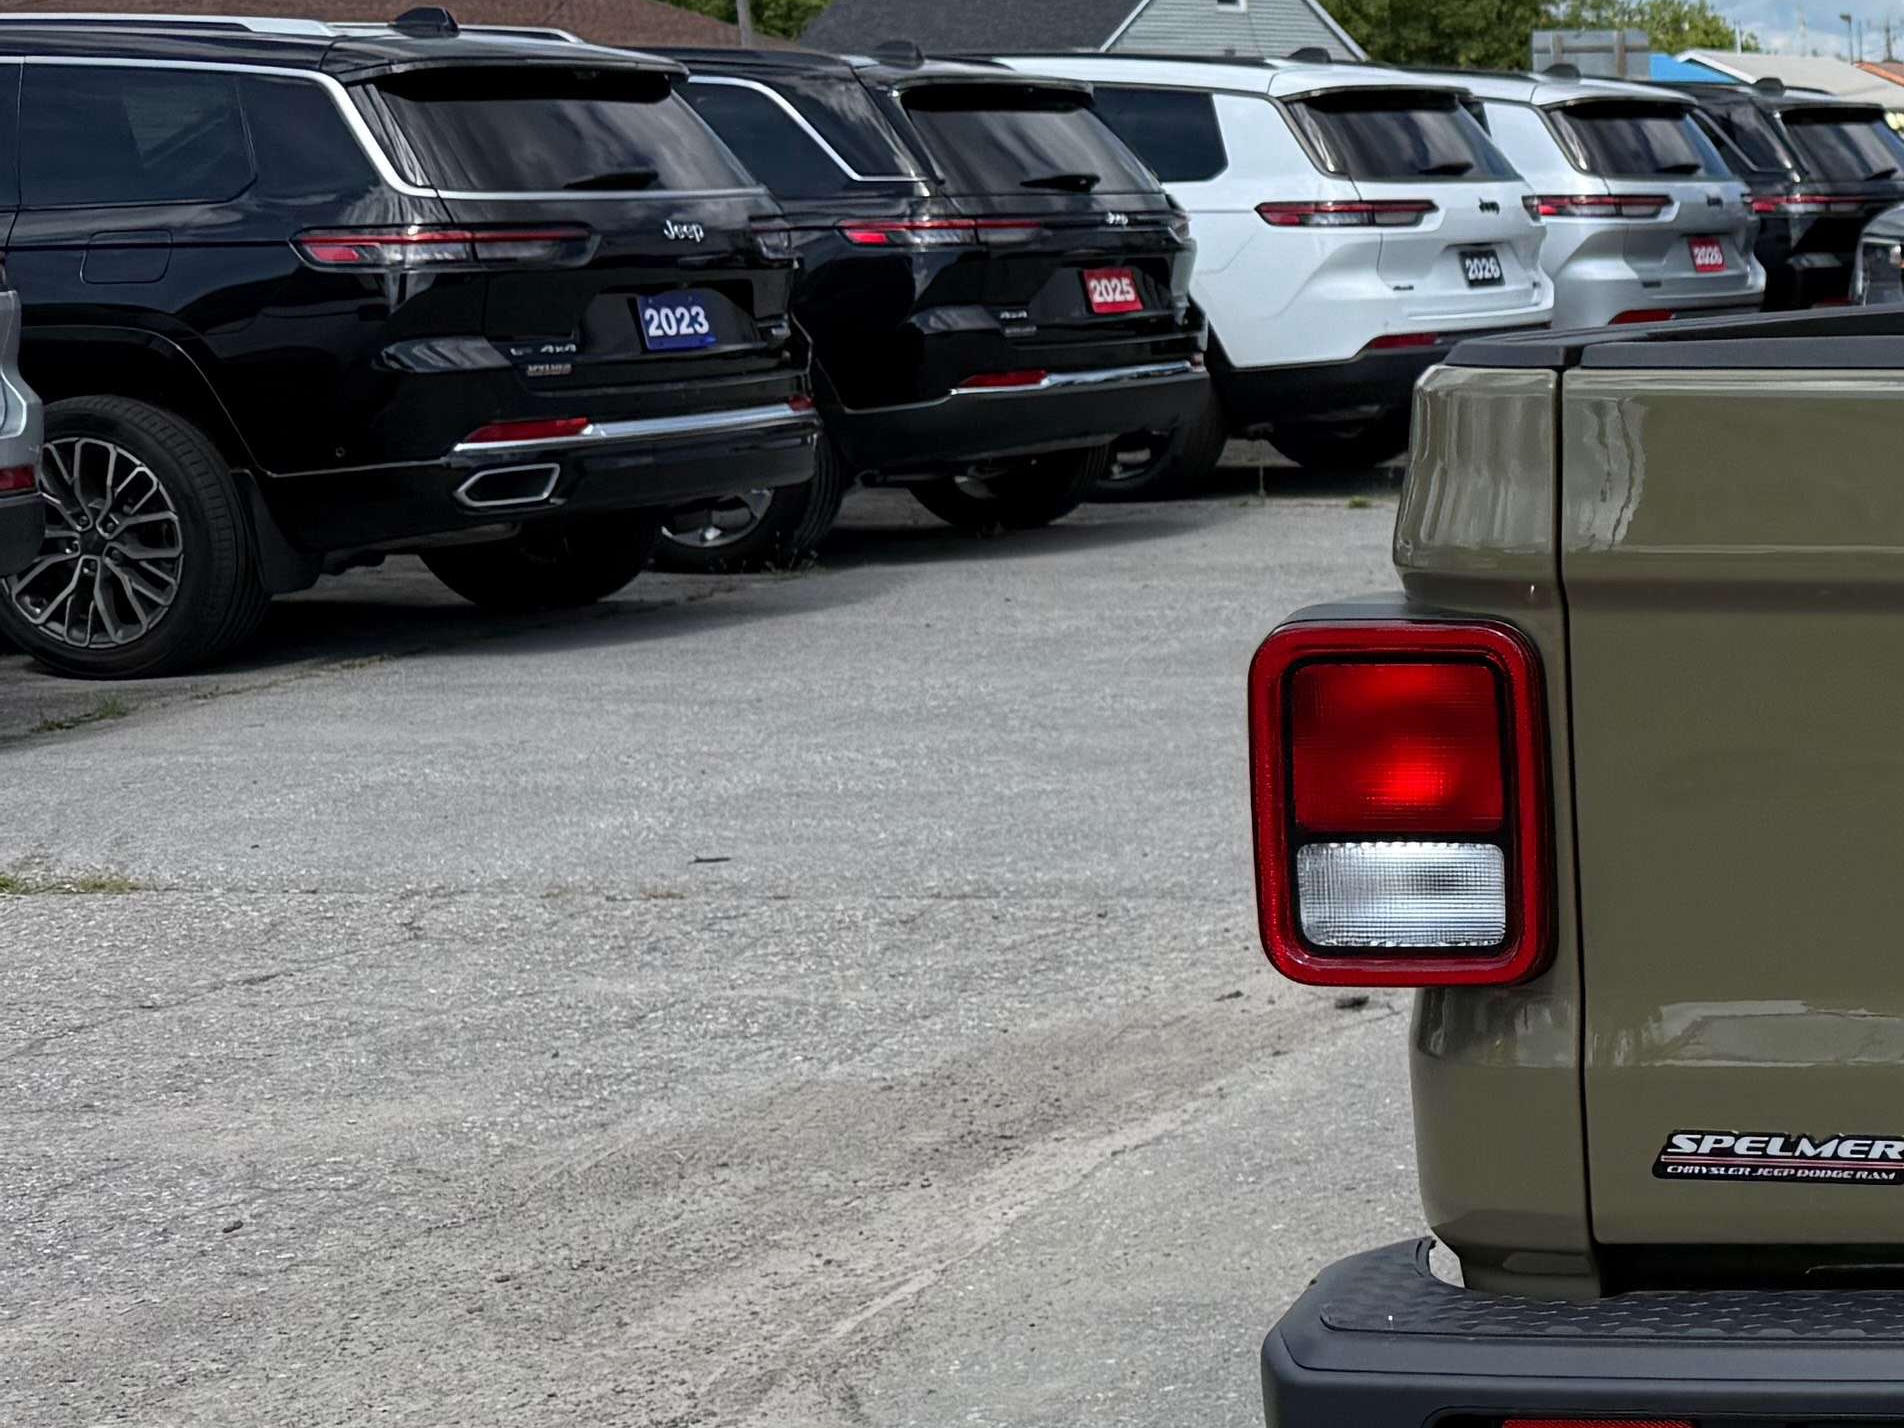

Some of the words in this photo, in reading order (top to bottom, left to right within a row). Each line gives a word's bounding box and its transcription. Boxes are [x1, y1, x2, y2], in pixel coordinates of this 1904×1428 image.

[664, 220, 705, 242] Jeep
[1465, 256, 1501, 280] 2026
[1089, 277, 1137, 303] 2025
[644, 305, 710, 337] 2023
[1666, 1164, 1751, 1176] CHRYSLER
[1752, 1167, 1796, 1177] JEEP
[1796, 1169, 1852, 1179] DODGE
[1854, 1171, 1896, 1180] RAM
